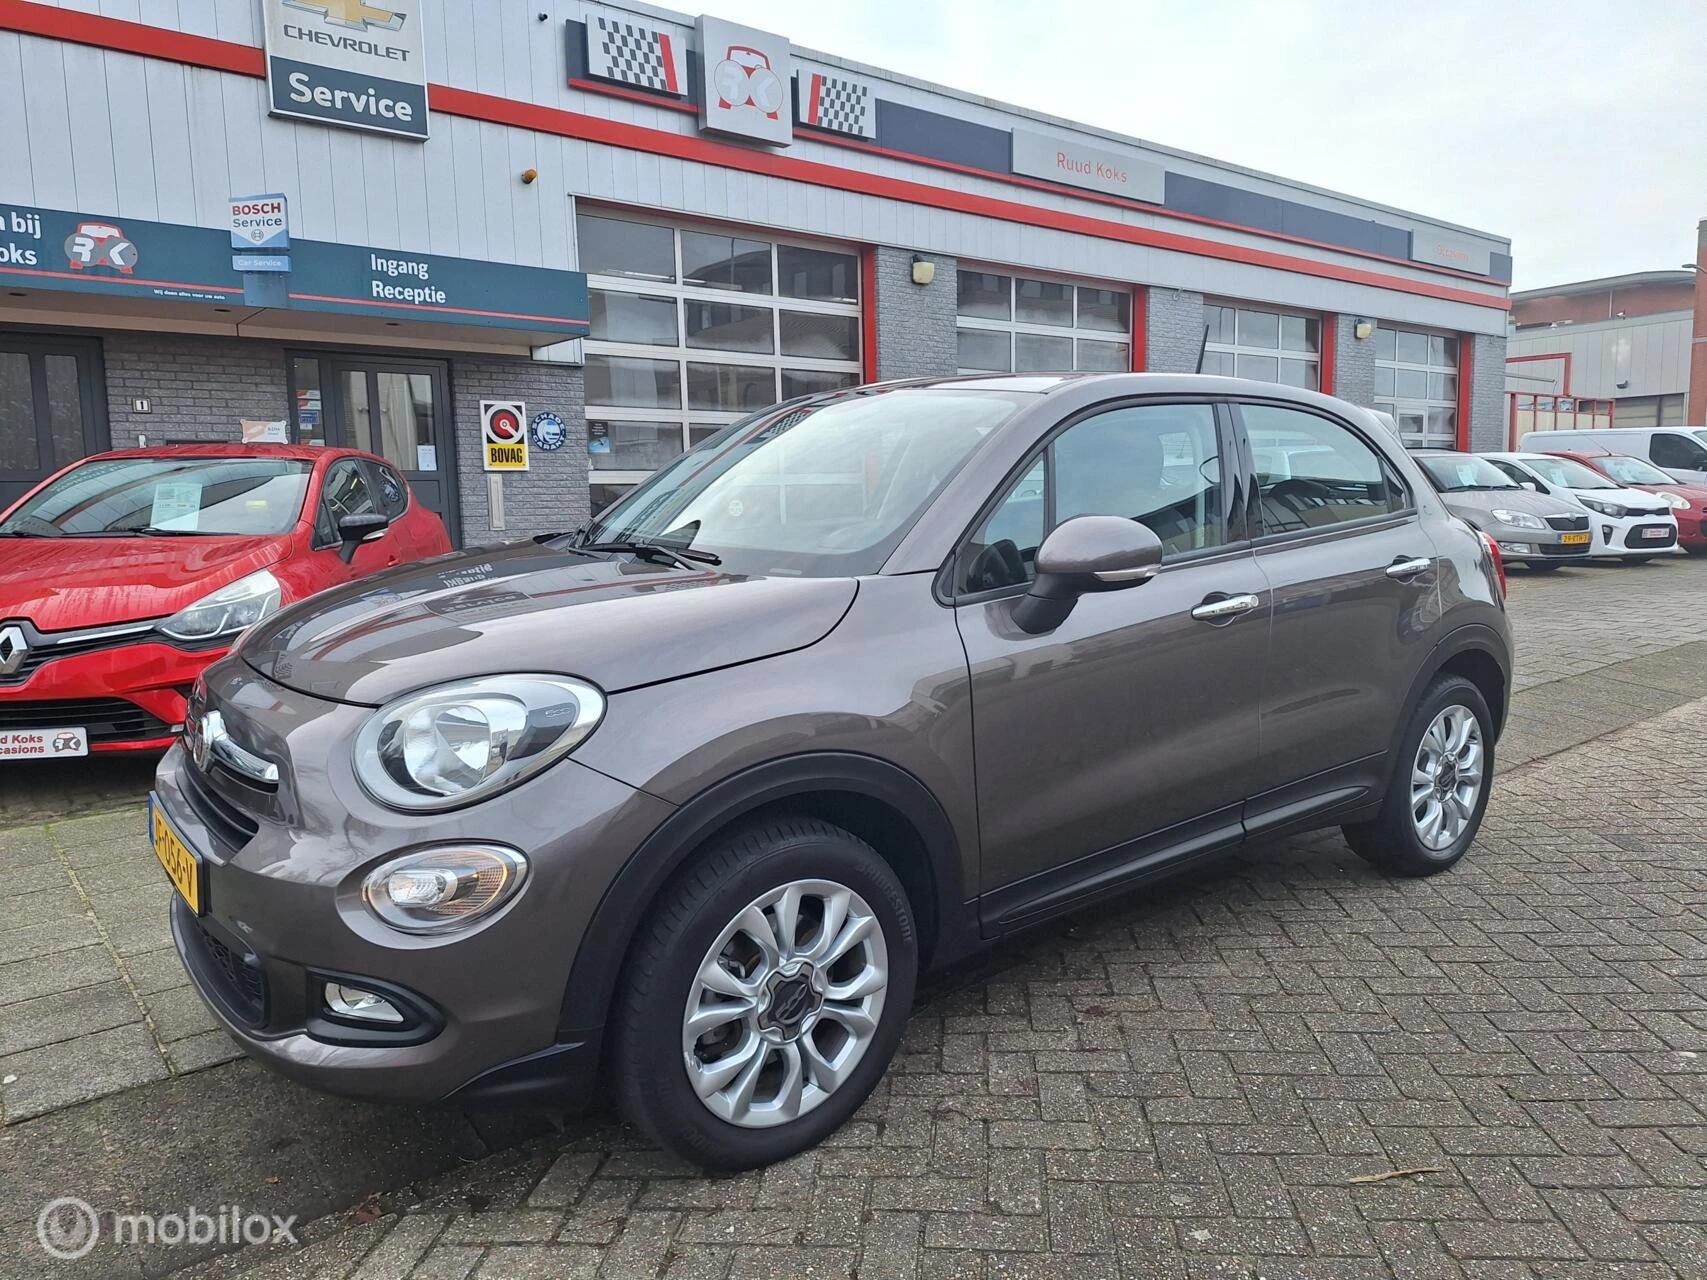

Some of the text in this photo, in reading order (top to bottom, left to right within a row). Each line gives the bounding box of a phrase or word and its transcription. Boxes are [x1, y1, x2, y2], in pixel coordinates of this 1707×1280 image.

[283, 24, 411, 62] CHEVROLET
[288, 71, 413, 122] Service
[1056, 152, 1127, 183] Ruud Koks
[232, 201, 282, 216] BOSCH
[10, 211, 42, 239] bij
[232, 216, 282, 228] Service
[370, 253, 429, 280] Ingang
[371, 279, 446, 305] Receptie
[490, 447, 523, 464] BOVAG
[12, 734, 43, 744] Koks
